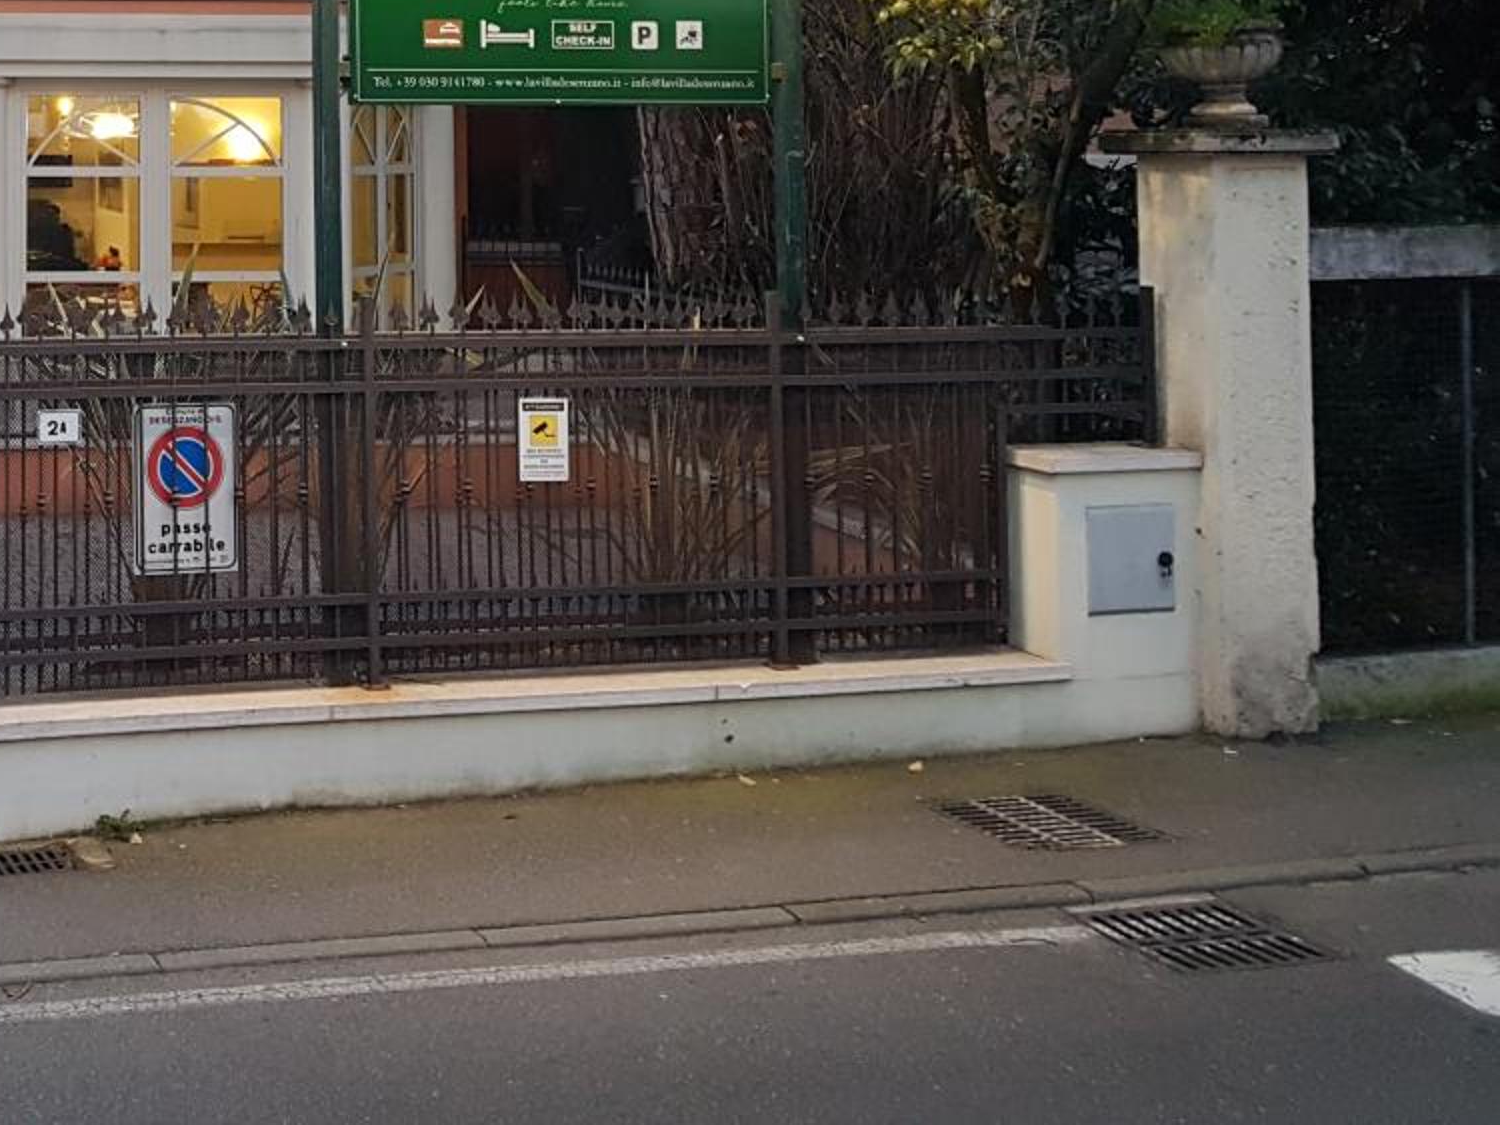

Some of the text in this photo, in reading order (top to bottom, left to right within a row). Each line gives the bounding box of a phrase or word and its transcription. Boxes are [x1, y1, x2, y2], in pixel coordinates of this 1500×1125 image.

[569, 23, 596, 33] SELF
[555, 36, 611, 46] CHECK-IN
[637, 26, 651, 44] P
[148, 538, 225, 554] carrable
